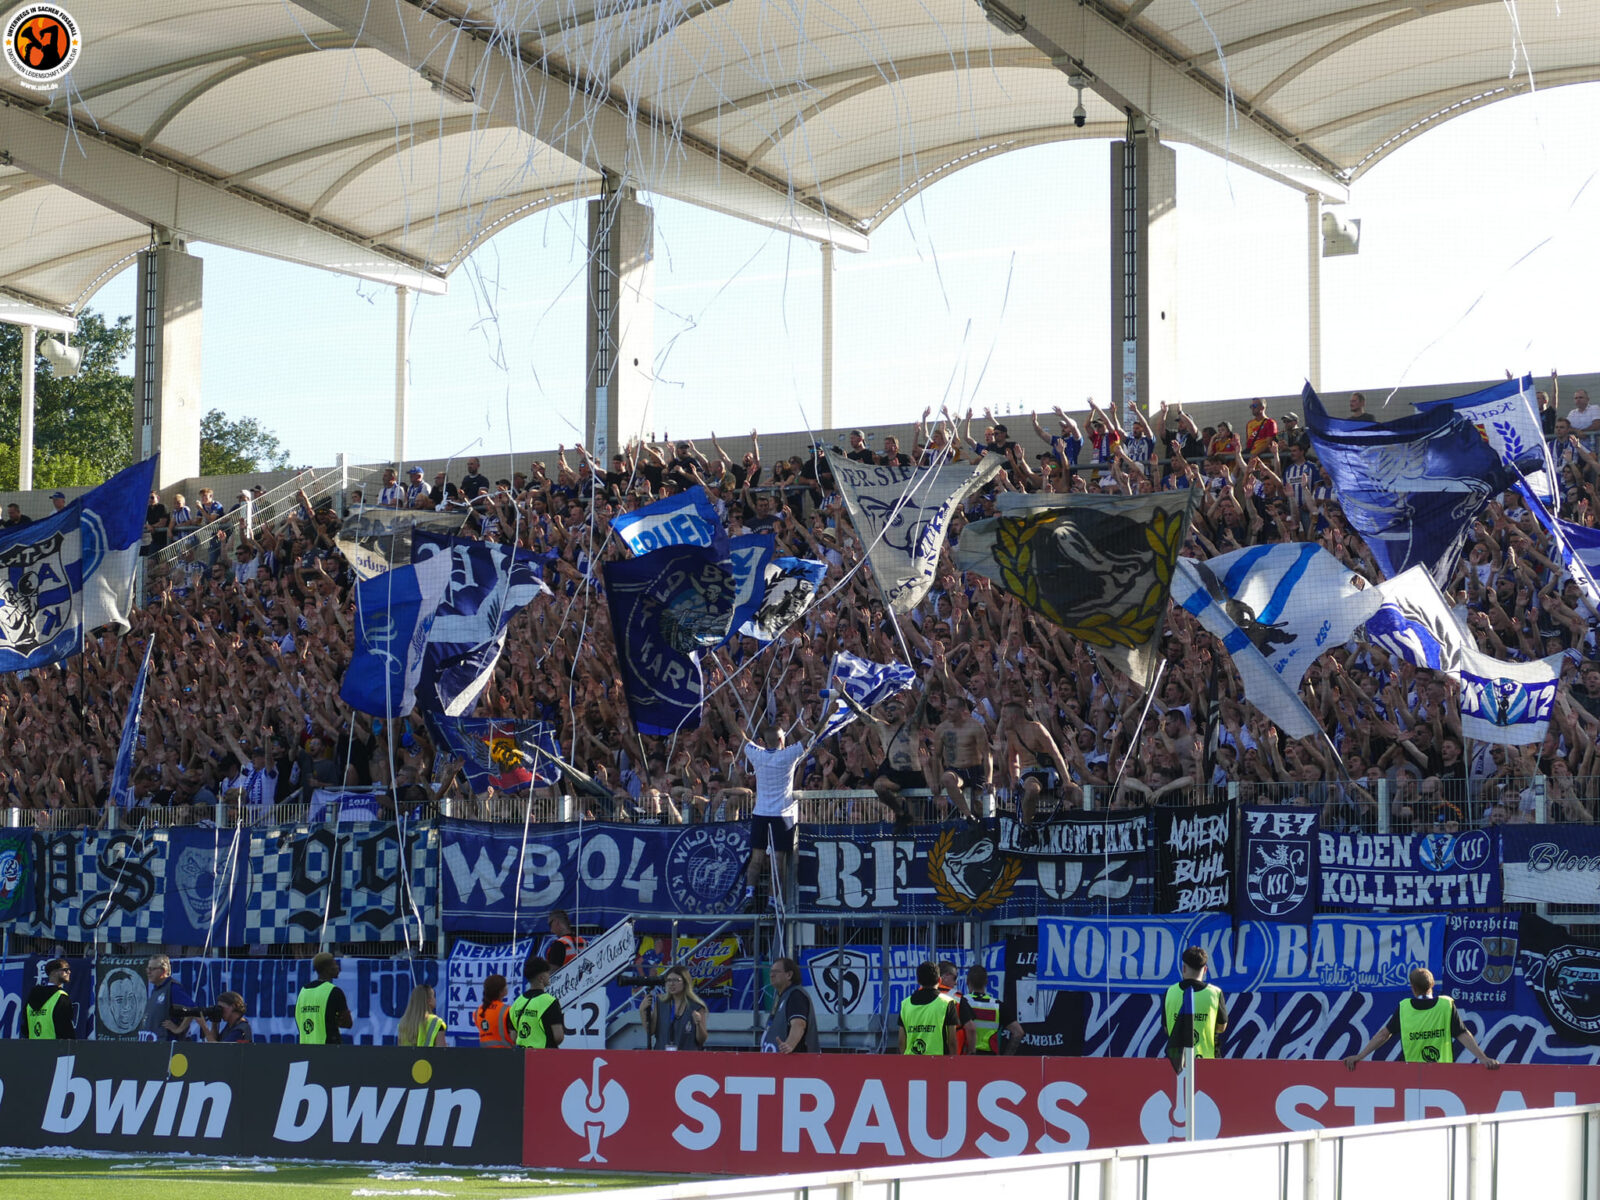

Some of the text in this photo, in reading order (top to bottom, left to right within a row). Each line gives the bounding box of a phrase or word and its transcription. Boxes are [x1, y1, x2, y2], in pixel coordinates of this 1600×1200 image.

[1528, 687, 1556, 718] 12
[1163, 805, 1230, 857] ACHERN
[1245, 811, 1318, 839] 767
[673, 828, 751, 864] WILD BOYS
[1319, 832, 1413, 868] BADEN
[1461, 837, 1485, 862] KSC
[1168, 850, 1231, 885] BÜHL
[1170, 876, 1230, 913] BADEN
[1267, 872, 1289, 895] KSC
[1321, 872, 1492, 906] KOLLEKTIV
[1451, 915, 1519, 931] Pforzheim
[453, 941, 535, 958] NERVEN
[1044, 923, 1176, 981] NORD
[1276, 921, 1433, 981] BADEN
[1456, 948, 1480, 973] KSC
[450, 961, 523, 978] KLINIK
[1320, 963, 1349, 986] steht
[1350, 970, 1380, 992] zum
[1451, 987, 1508, 1003] Enzkreis
[1021, 1032, 1064, 1047] AMBLE
[1409, 1029, 1445, 1040] SICHERHEIT
[41, 1053, 482, 1147] bwin bwin
[671, 1073, 1091, 1158] STRAUSS
